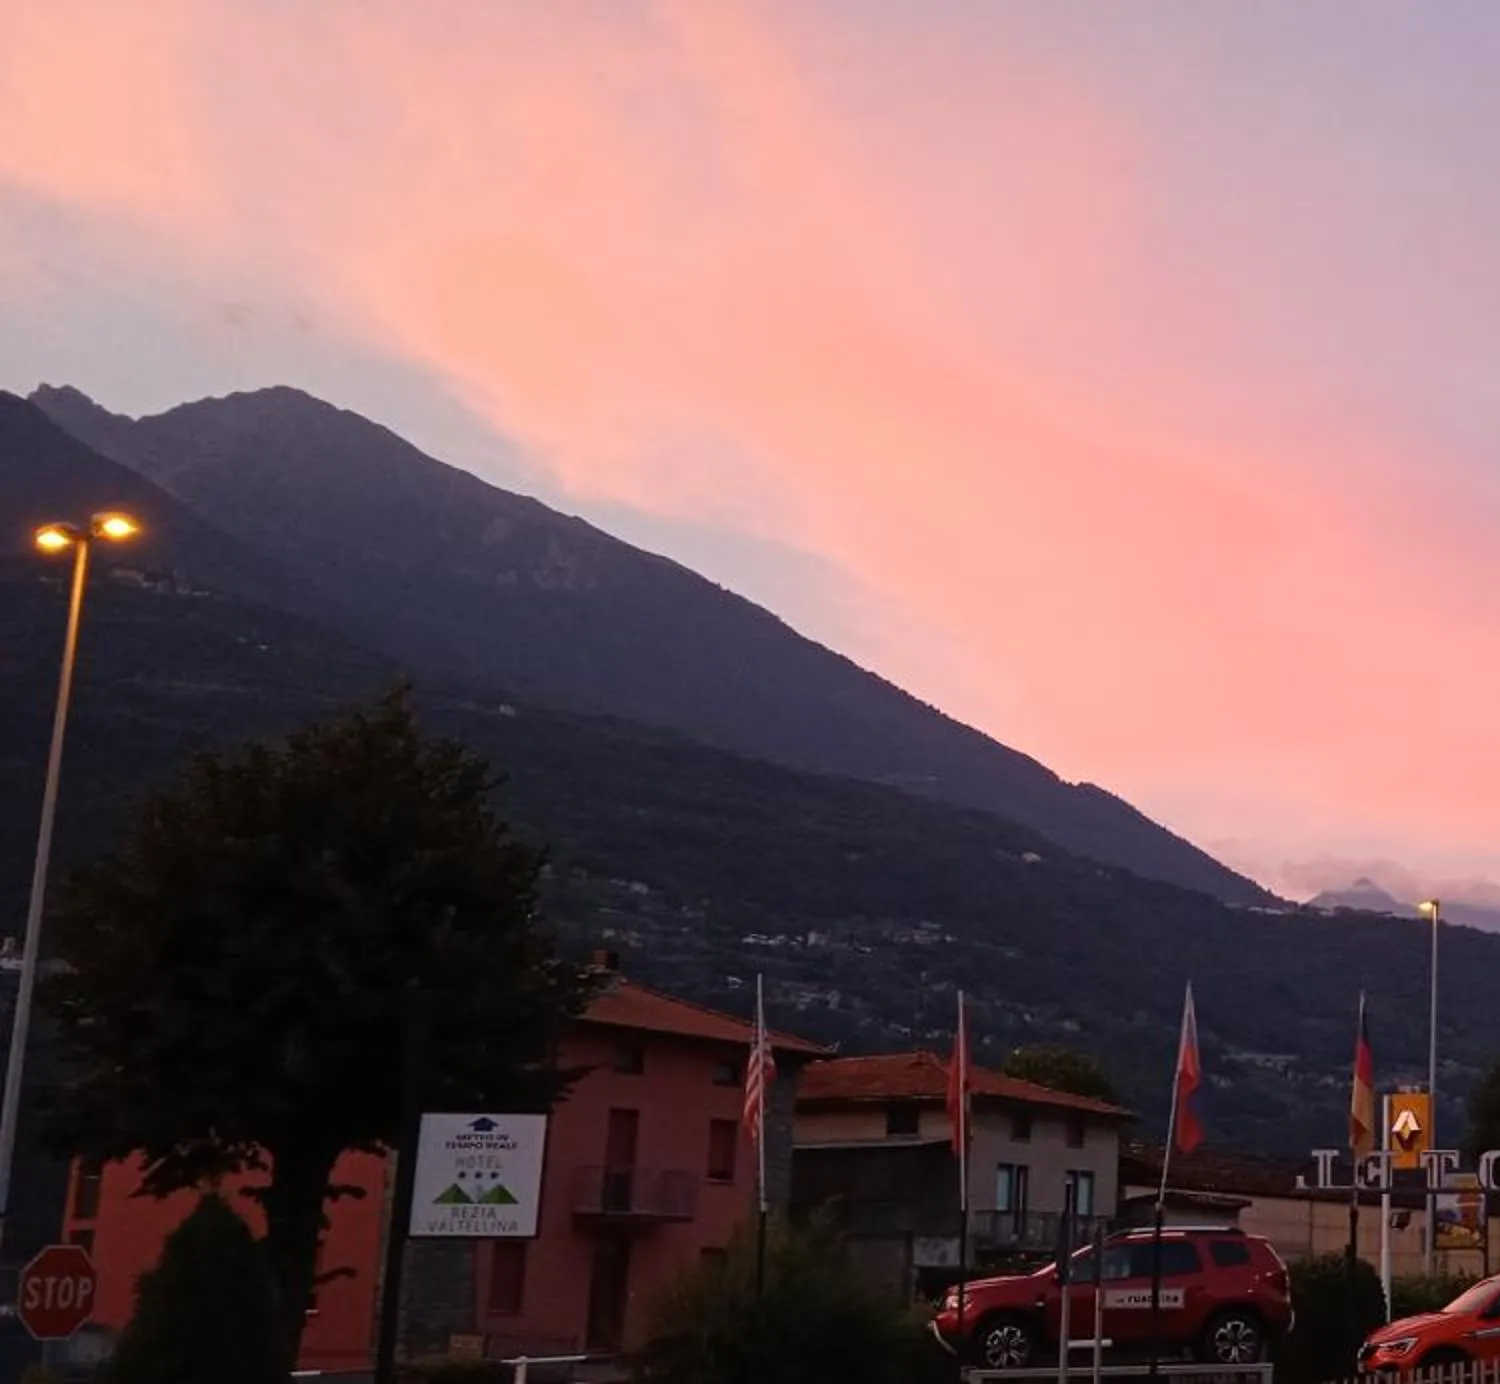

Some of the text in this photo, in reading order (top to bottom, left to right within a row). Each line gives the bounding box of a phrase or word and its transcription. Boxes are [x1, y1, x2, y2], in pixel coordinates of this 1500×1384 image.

[455, 1155, 503, 1169] HOTEL
[451, 1206, 496, 1219] REZIA
[427, 1220, 518, 1233] VALTELLINA
[24, 1276, 93, 1310] STOP
